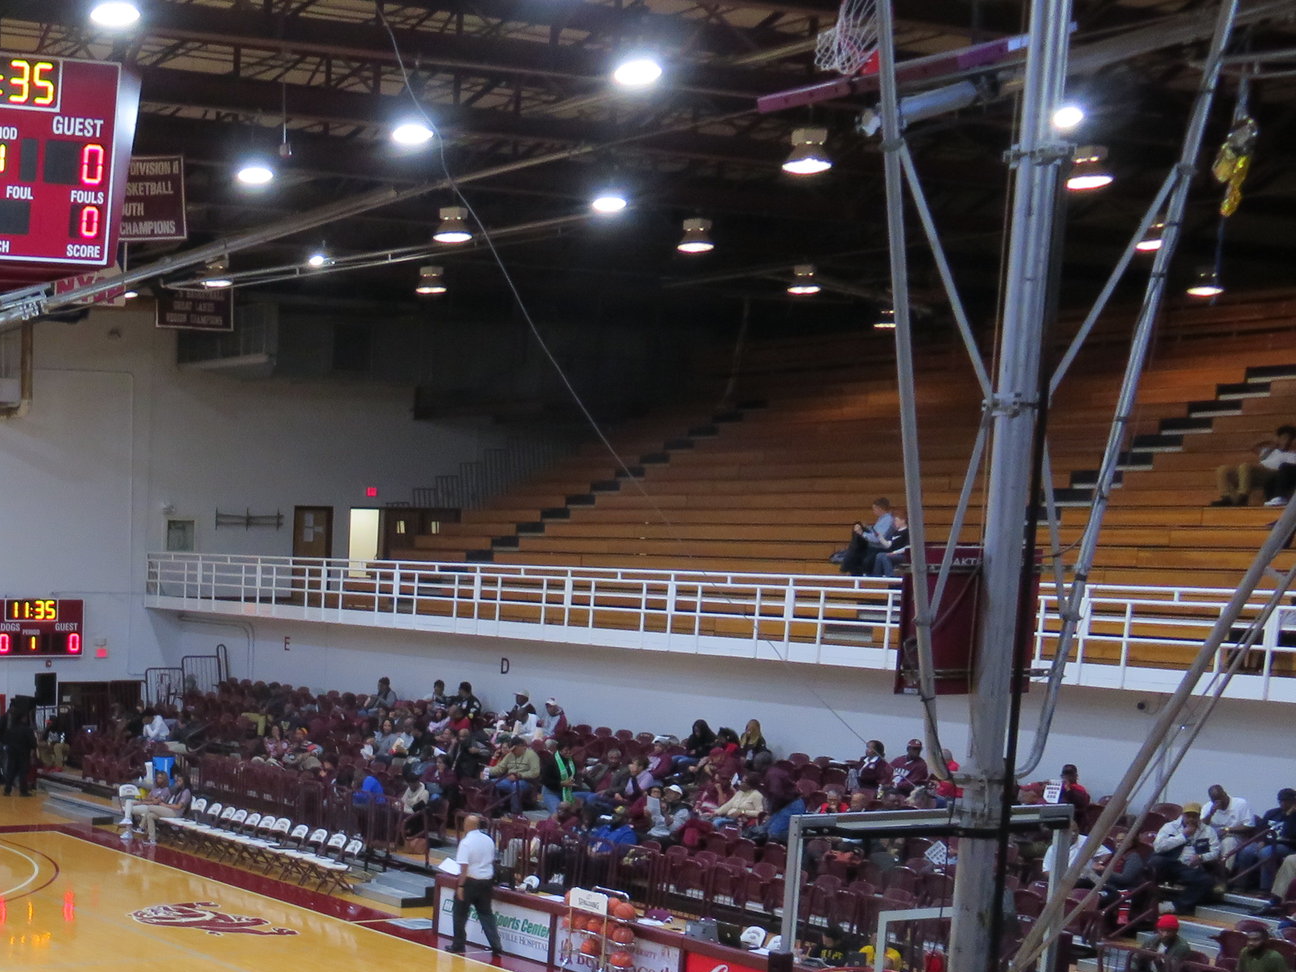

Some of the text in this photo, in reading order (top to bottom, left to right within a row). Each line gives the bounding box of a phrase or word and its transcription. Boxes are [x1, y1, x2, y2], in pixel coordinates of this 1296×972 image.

[52, 115, 104, 137] GUEST
[81, 143, 105, 186] 0
[130, 161, 171, 176] DIVISION
[6, 186, 33, 200] FOUL
[126, 182, 174, 196] SKETBALL
[70, 190, 104, 204] FOULS
[80, 205, 100, 239] 0
[66, 244, 101, 258] SCORE
[13, 600, 56, 620] 11:35
[55, 622, 78, 631] GUEST
[31, 636, 36, 650] 1
[68, 633, 80, 652] 0
[284, 636, 290, 651] E
[500, 658, 510, 674] D
[521, 918, 550, 938] Center
[519, 936, 549, 951] HOSPITAL
